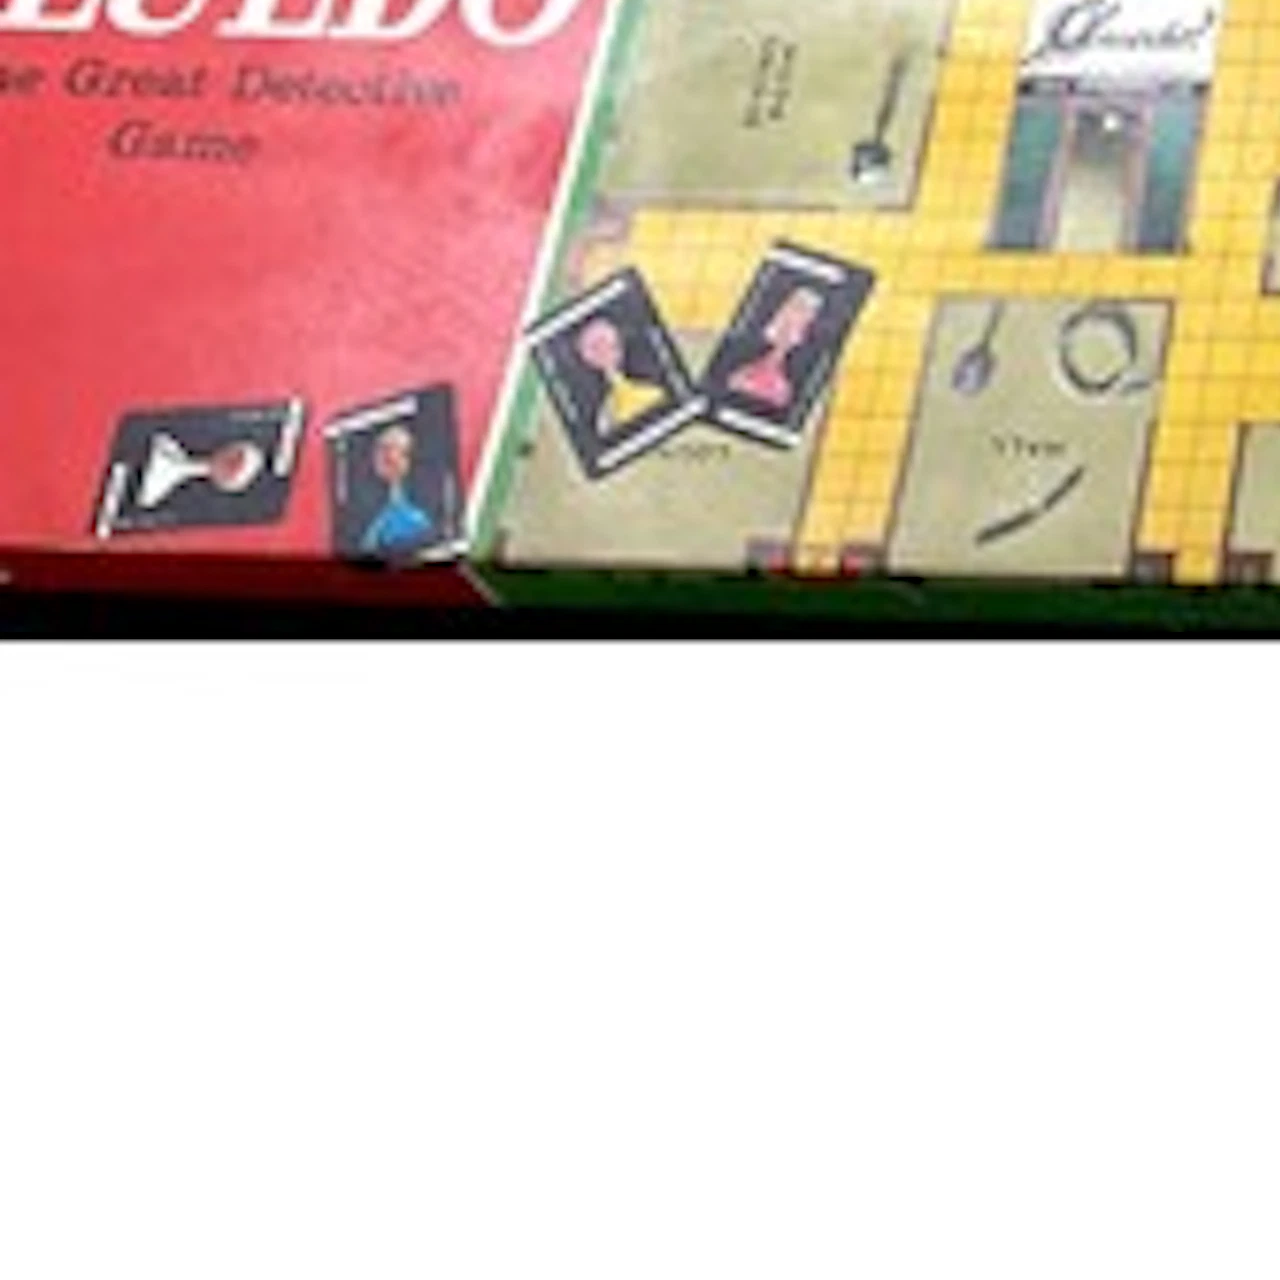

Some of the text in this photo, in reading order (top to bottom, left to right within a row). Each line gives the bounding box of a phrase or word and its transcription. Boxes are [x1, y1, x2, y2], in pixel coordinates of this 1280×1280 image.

[64, 58, 207, 99] Great
[231, 64, 461, 110] Detective
[109, 118, 259, 168] Game
